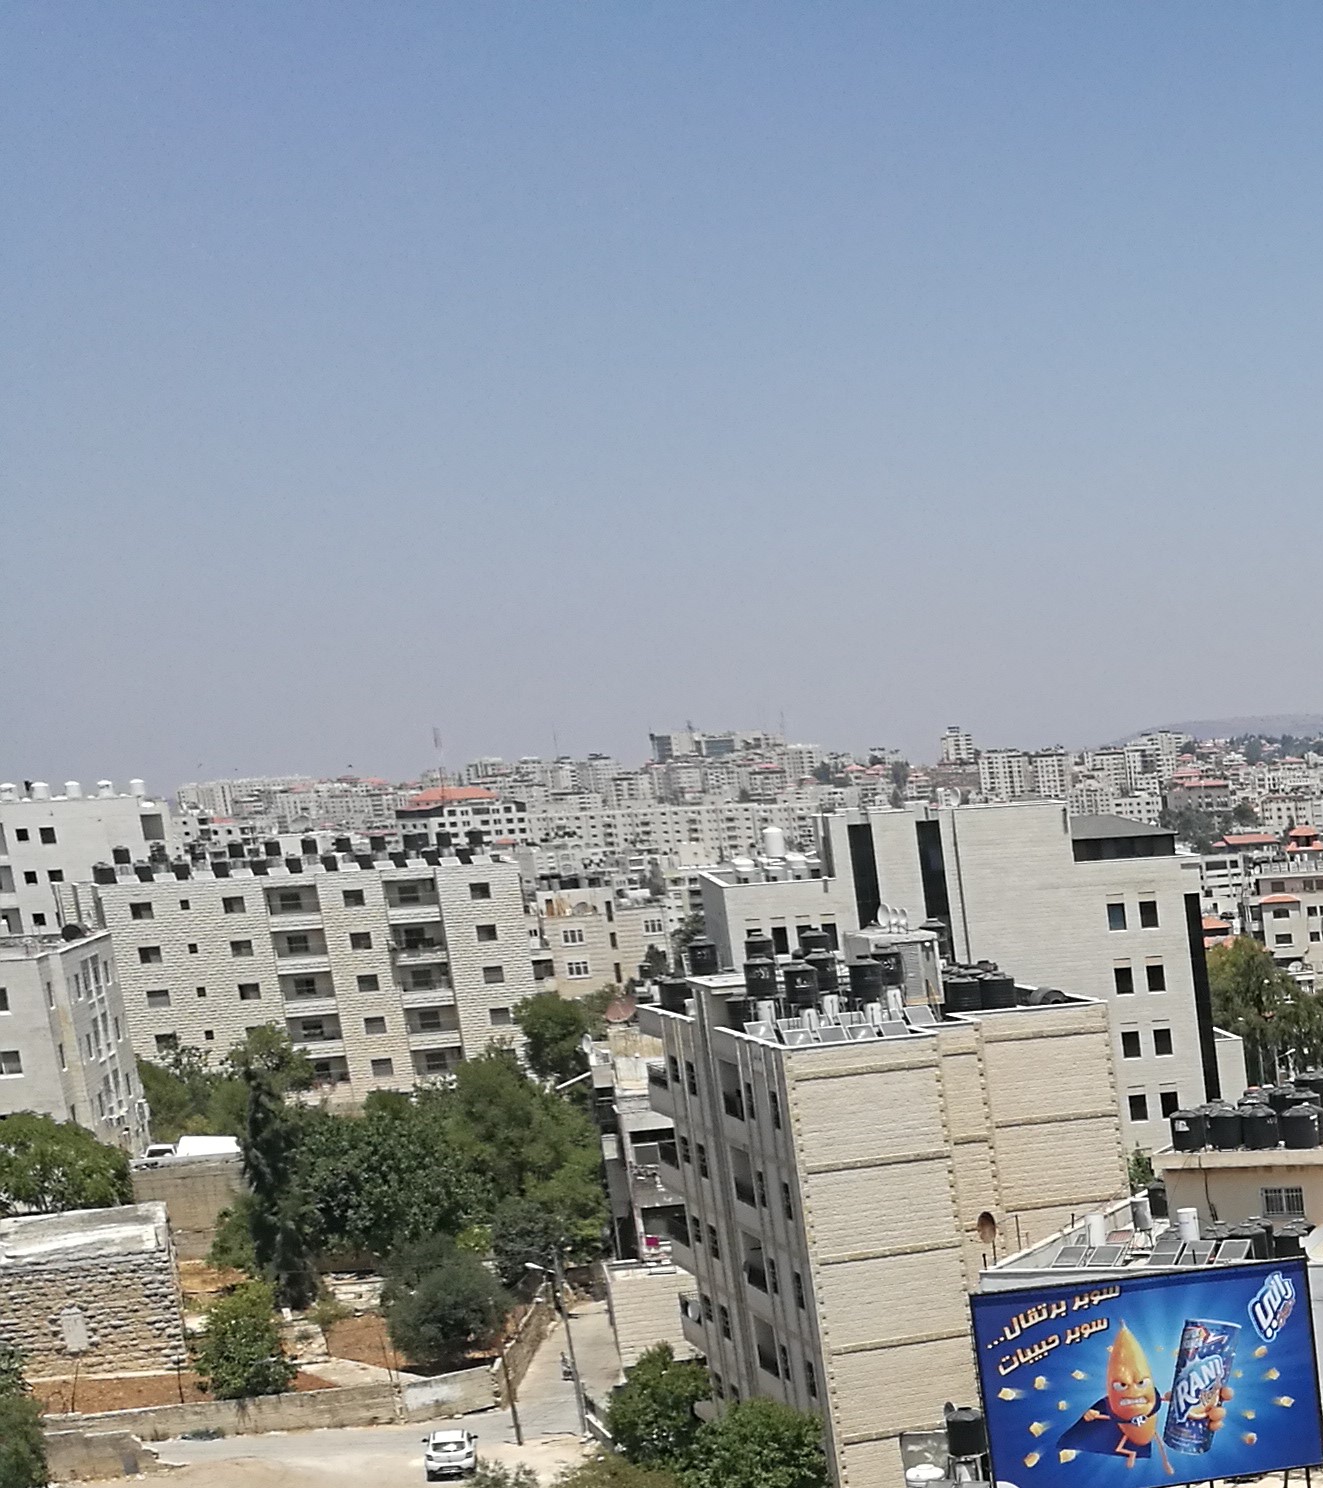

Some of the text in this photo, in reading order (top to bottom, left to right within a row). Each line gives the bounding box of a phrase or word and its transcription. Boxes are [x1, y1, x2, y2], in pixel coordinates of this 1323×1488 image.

[1072, 1285, 1121, 1311] سوبر
[998, 1317, 1108, 1376] سوبر حبيبات
[1176, 1358, 1224, 1412] RANI
